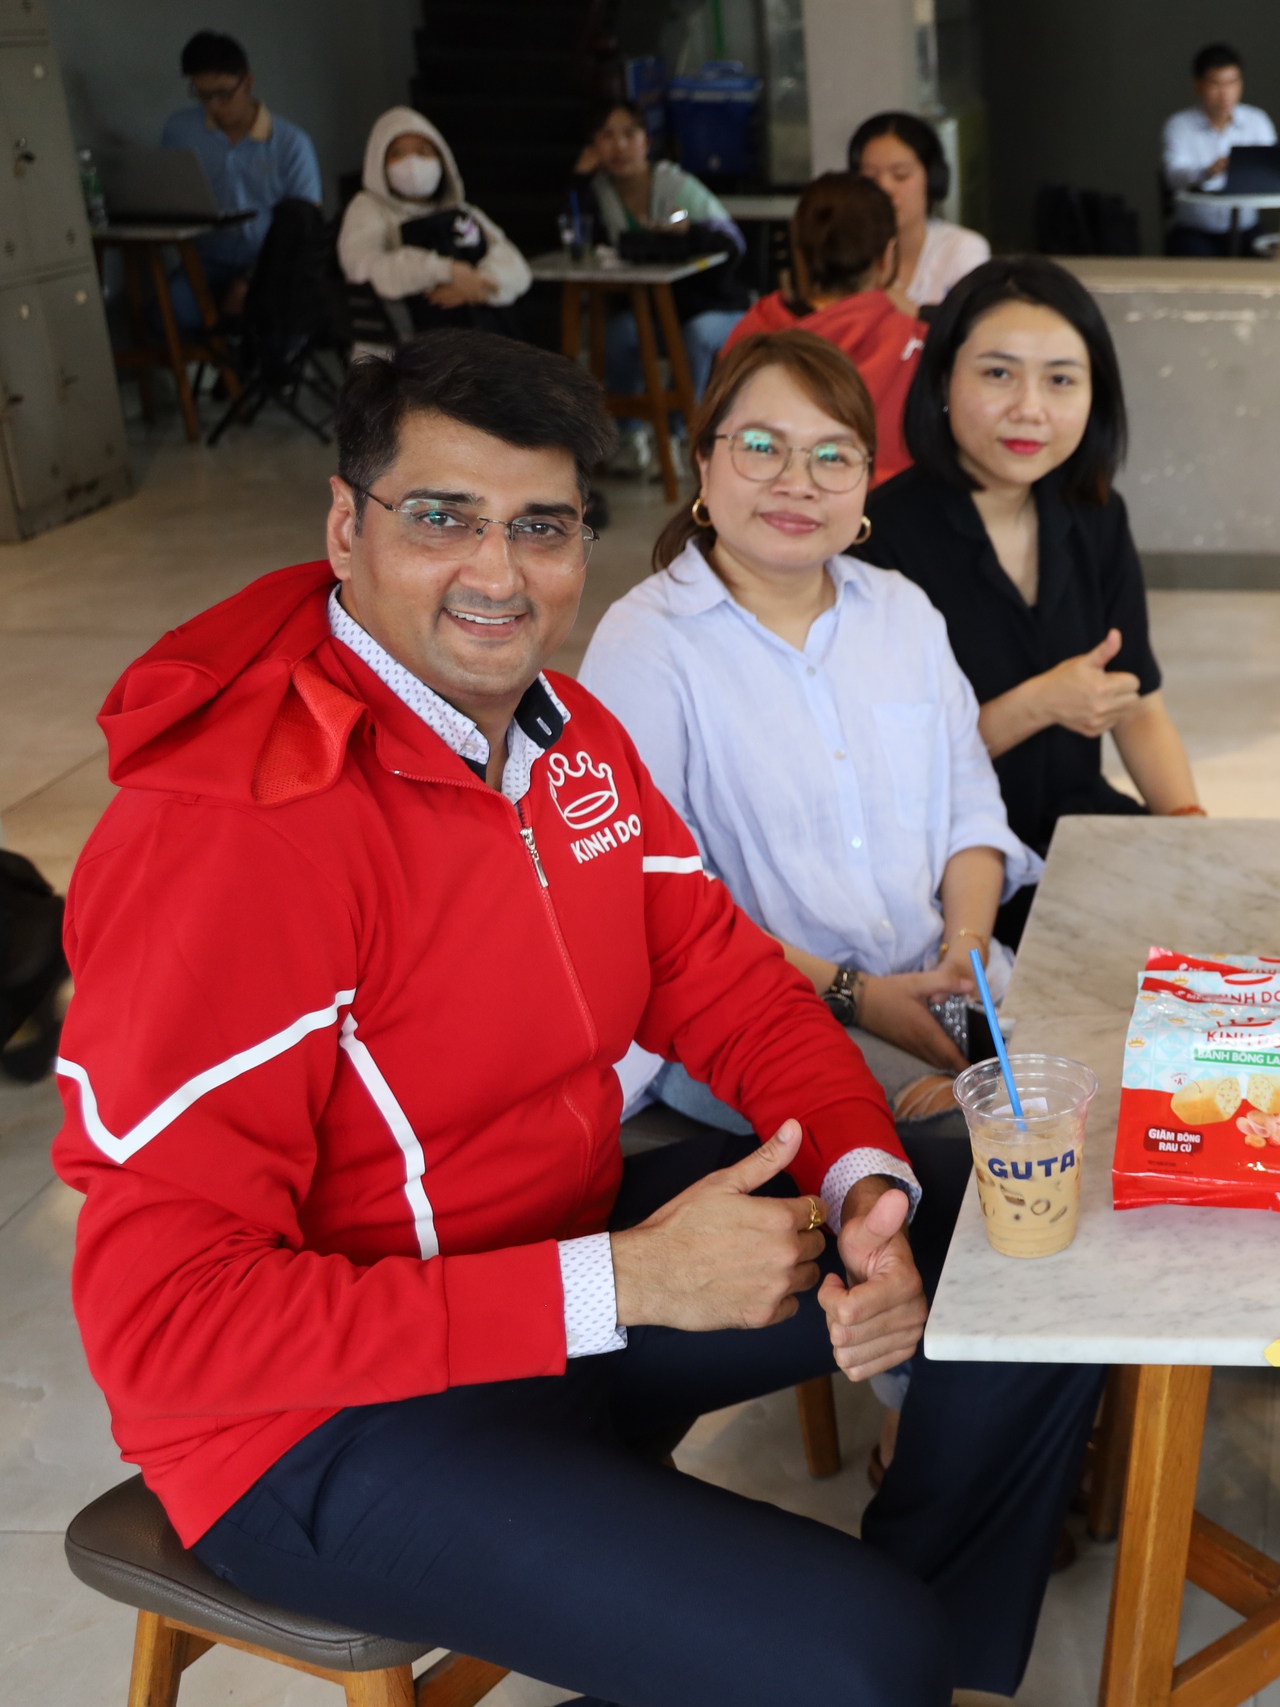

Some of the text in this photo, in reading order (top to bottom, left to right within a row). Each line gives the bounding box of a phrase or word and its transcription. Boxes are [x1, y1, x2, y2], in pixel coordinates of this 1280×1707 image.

[570, 814, 641, 864] KINH DO
[1158, 1142, 1179, 1152] RAU
[988, 1149, 1075, 1180] GUTA
